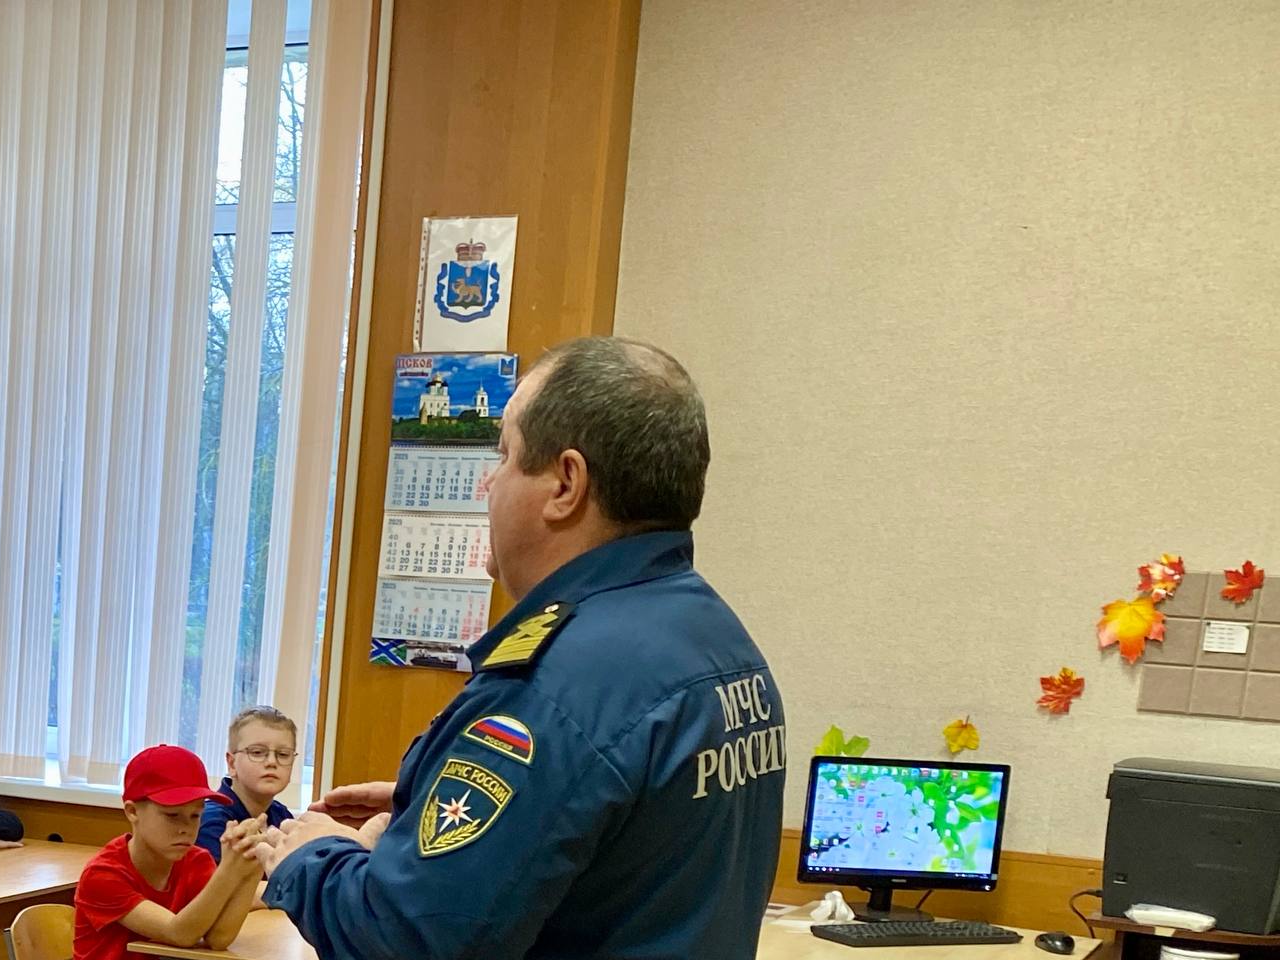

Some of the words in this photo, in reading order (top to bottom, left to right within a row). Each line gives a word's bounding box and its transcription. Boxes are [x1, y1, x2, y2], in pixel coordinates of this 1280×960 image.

[398, 358, 432, 368] ПСКОВ
[715, 674, 771, 732] МЧС
[445, 763, 472, 778] МЧС
[470, 769, 507, 802] РОССИИ
